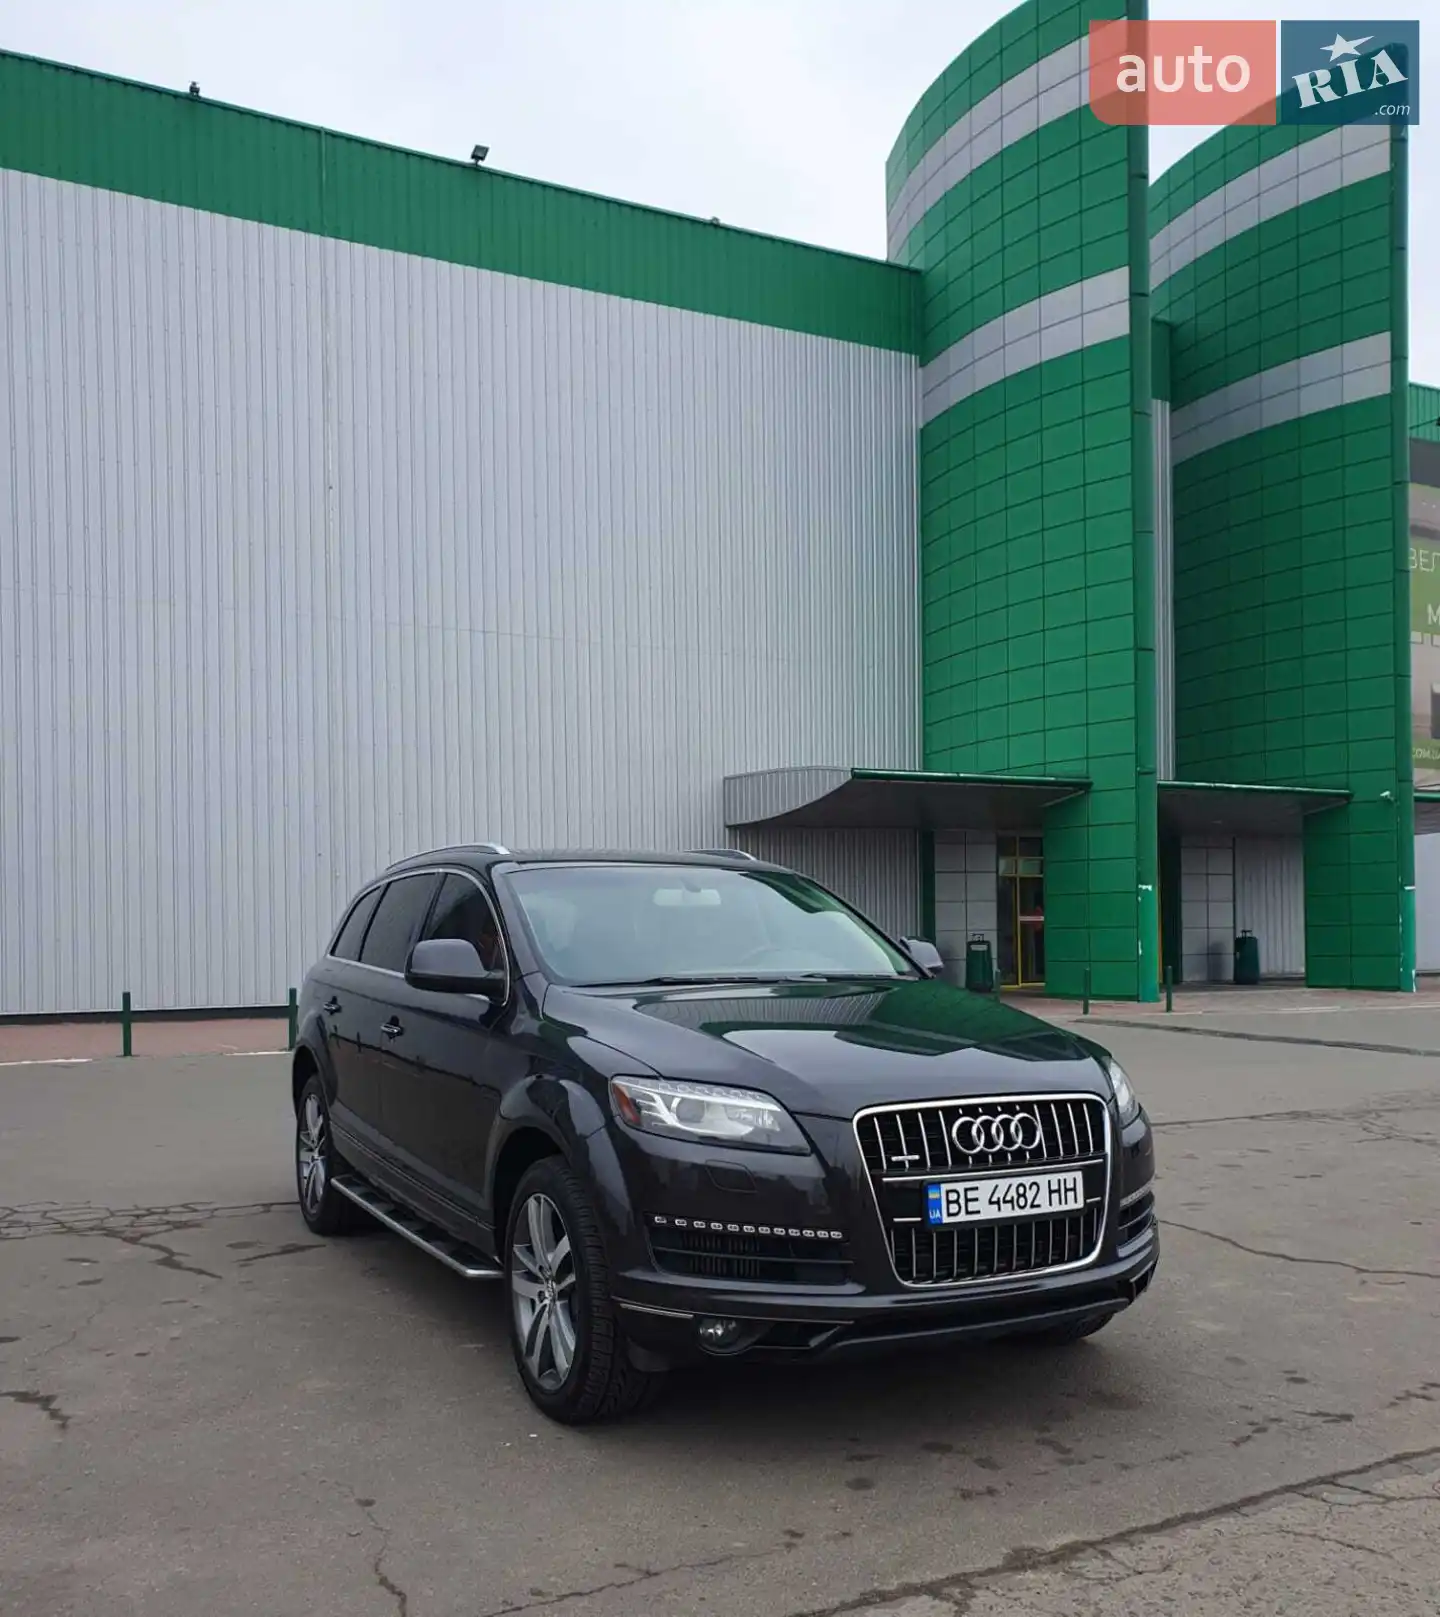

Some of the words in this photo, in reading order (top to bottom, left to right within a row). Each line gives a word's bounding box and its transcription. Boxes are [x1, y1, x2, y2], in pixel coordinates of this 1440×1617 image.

[945, 1186, 981, 1217] BE
[988, 1181, 1041, 1212] 4482
[1047, 1177, 1078, 1207] HH
[929, 1209, 941, 1219] UA
